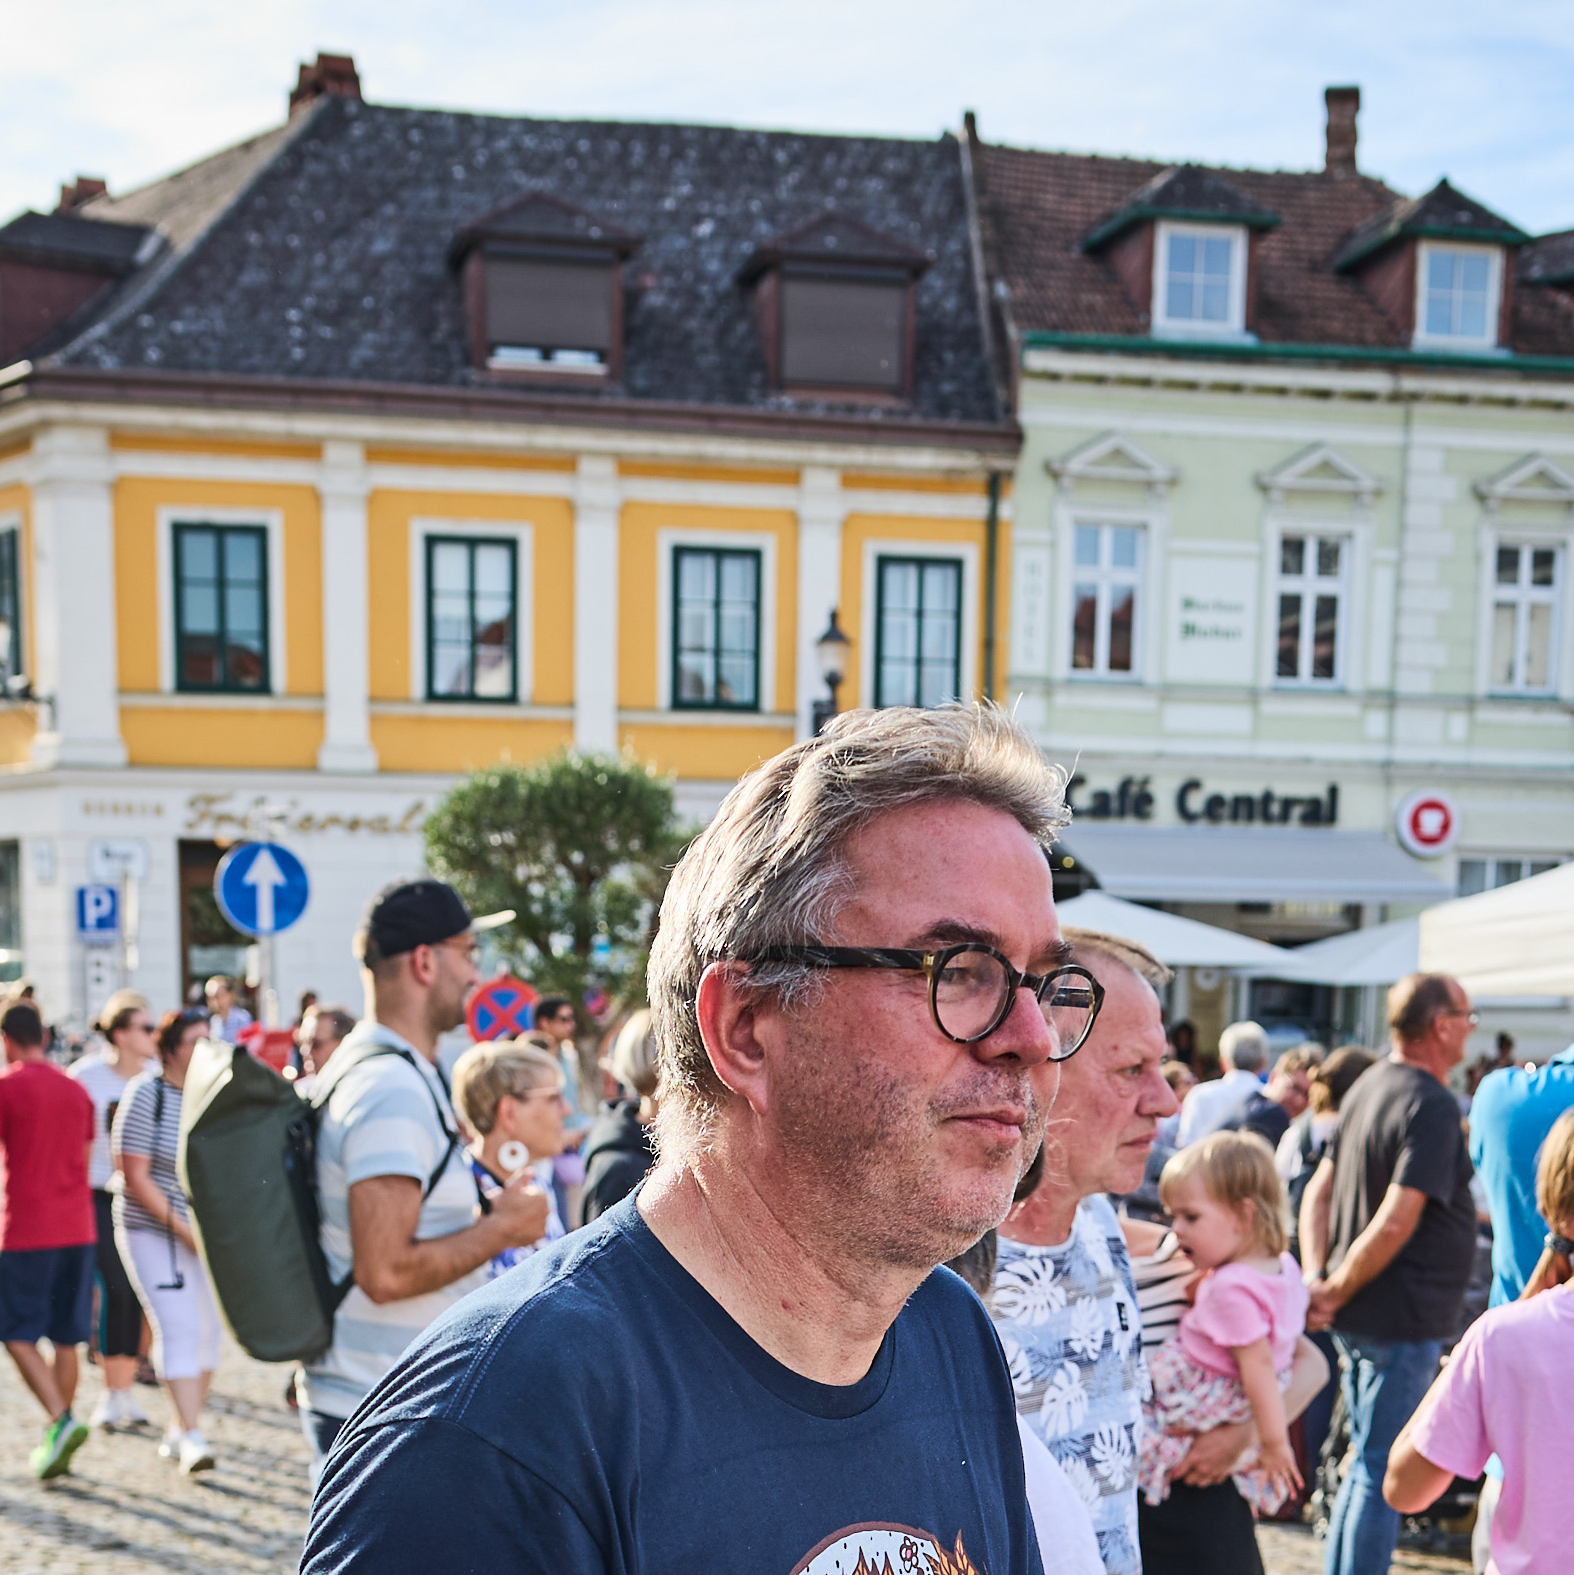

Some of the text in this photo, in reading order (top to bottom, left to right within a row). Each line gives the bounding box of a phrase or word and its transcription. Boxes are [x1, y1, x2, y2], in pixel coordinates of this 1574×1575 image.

[1068, 774, 1339, 825] Café Central
[84, 887, 113, 928] P
